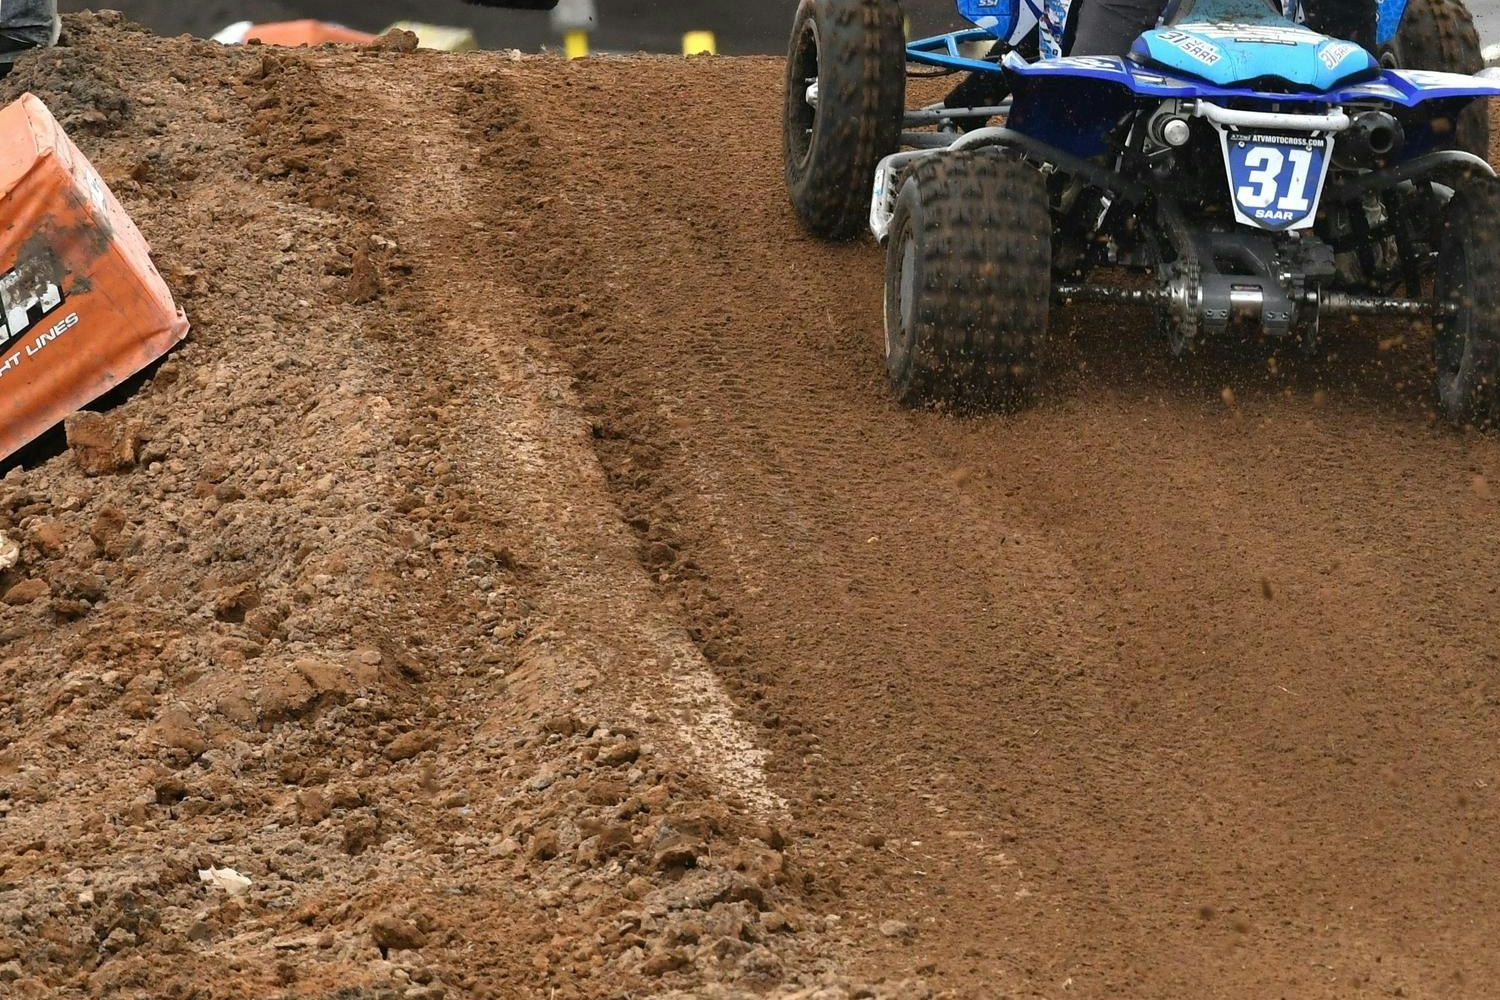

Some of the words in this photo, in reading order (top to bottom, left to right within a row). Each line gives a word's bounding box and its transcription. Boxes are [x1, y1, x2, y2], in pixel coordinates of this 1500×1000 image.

[1252, 134, 1325, 148] ATVMOTOCROSS.COM
[1237, 146, 1313, 212] 31
[1255, 209, 1294, 220] SAAR
[25, 312, 79, 356] LINES
